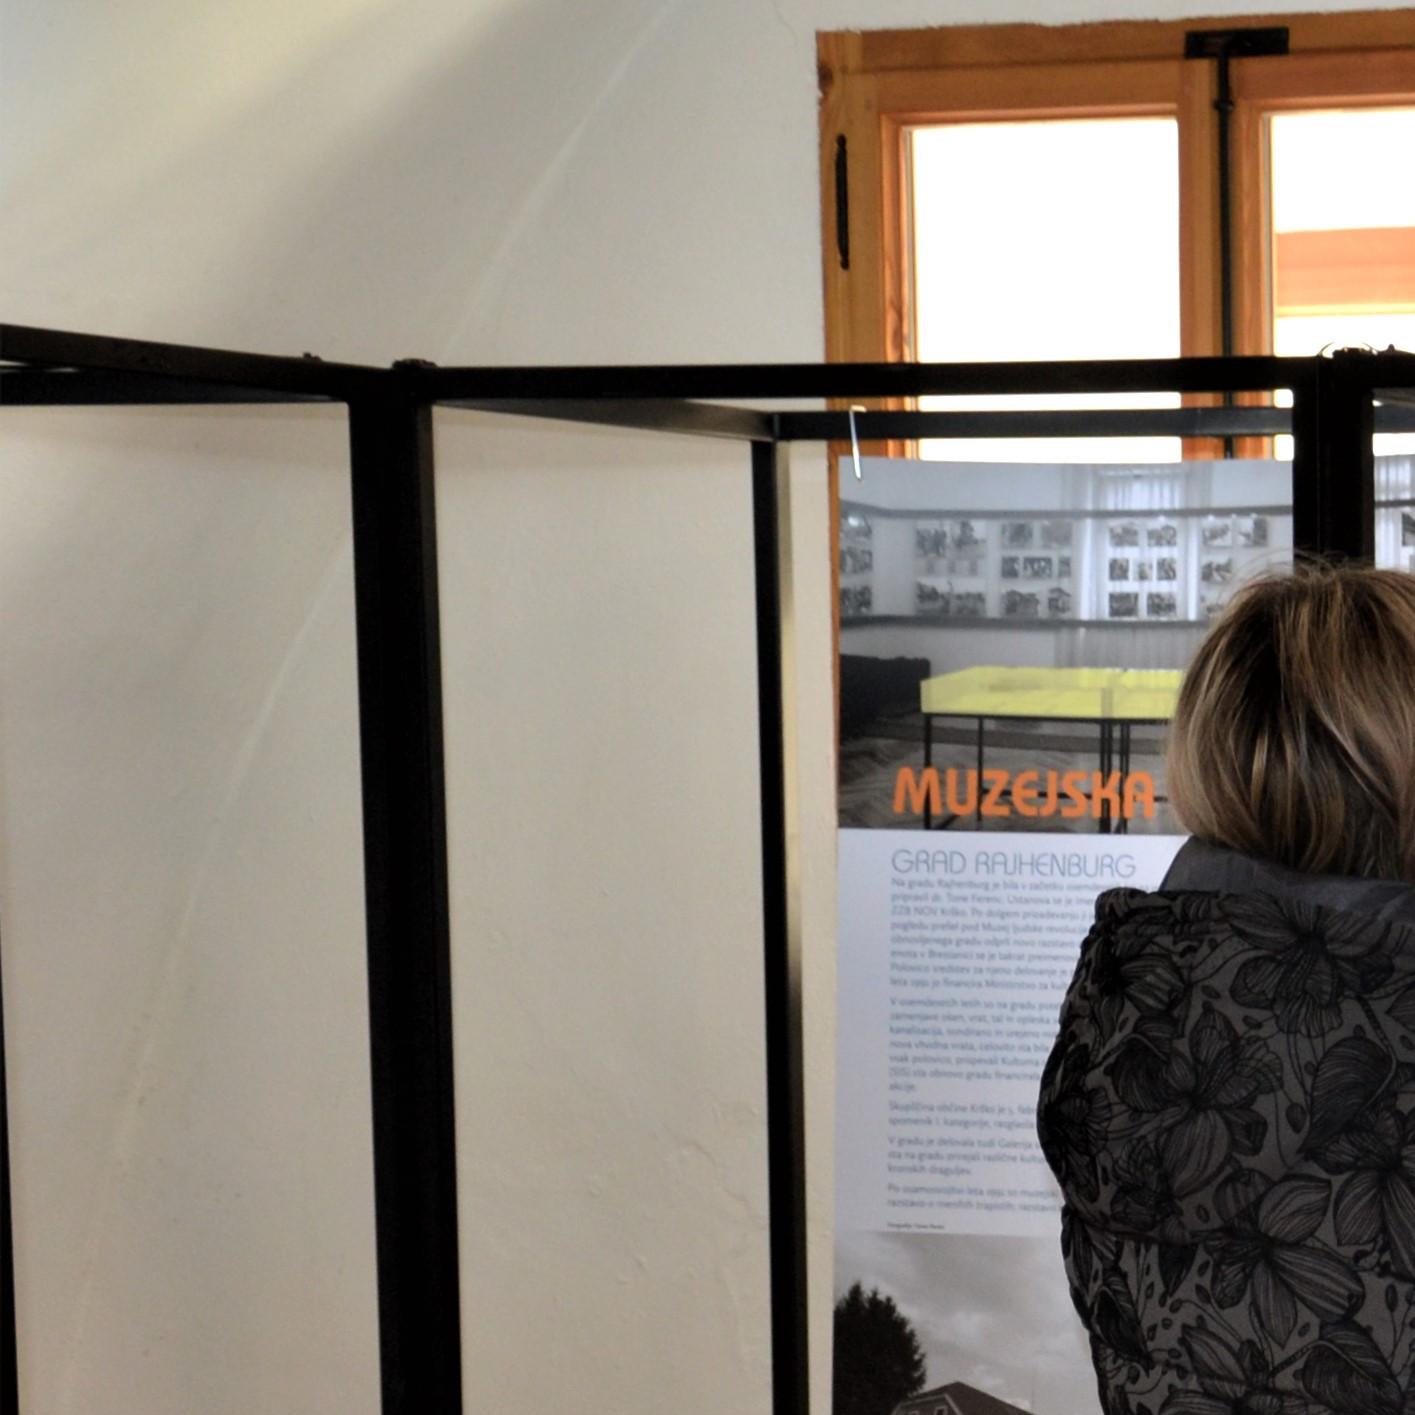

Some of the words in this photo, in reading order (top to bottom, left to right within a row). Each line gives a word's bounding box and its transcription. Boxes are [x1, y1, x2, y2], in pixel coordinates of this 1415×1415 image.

[891, 766, 1156, 819] MUZEJSKA
[891, 849, 967, 874] GRAD
[975, 850, 1136, 878] RAJHENBURG
